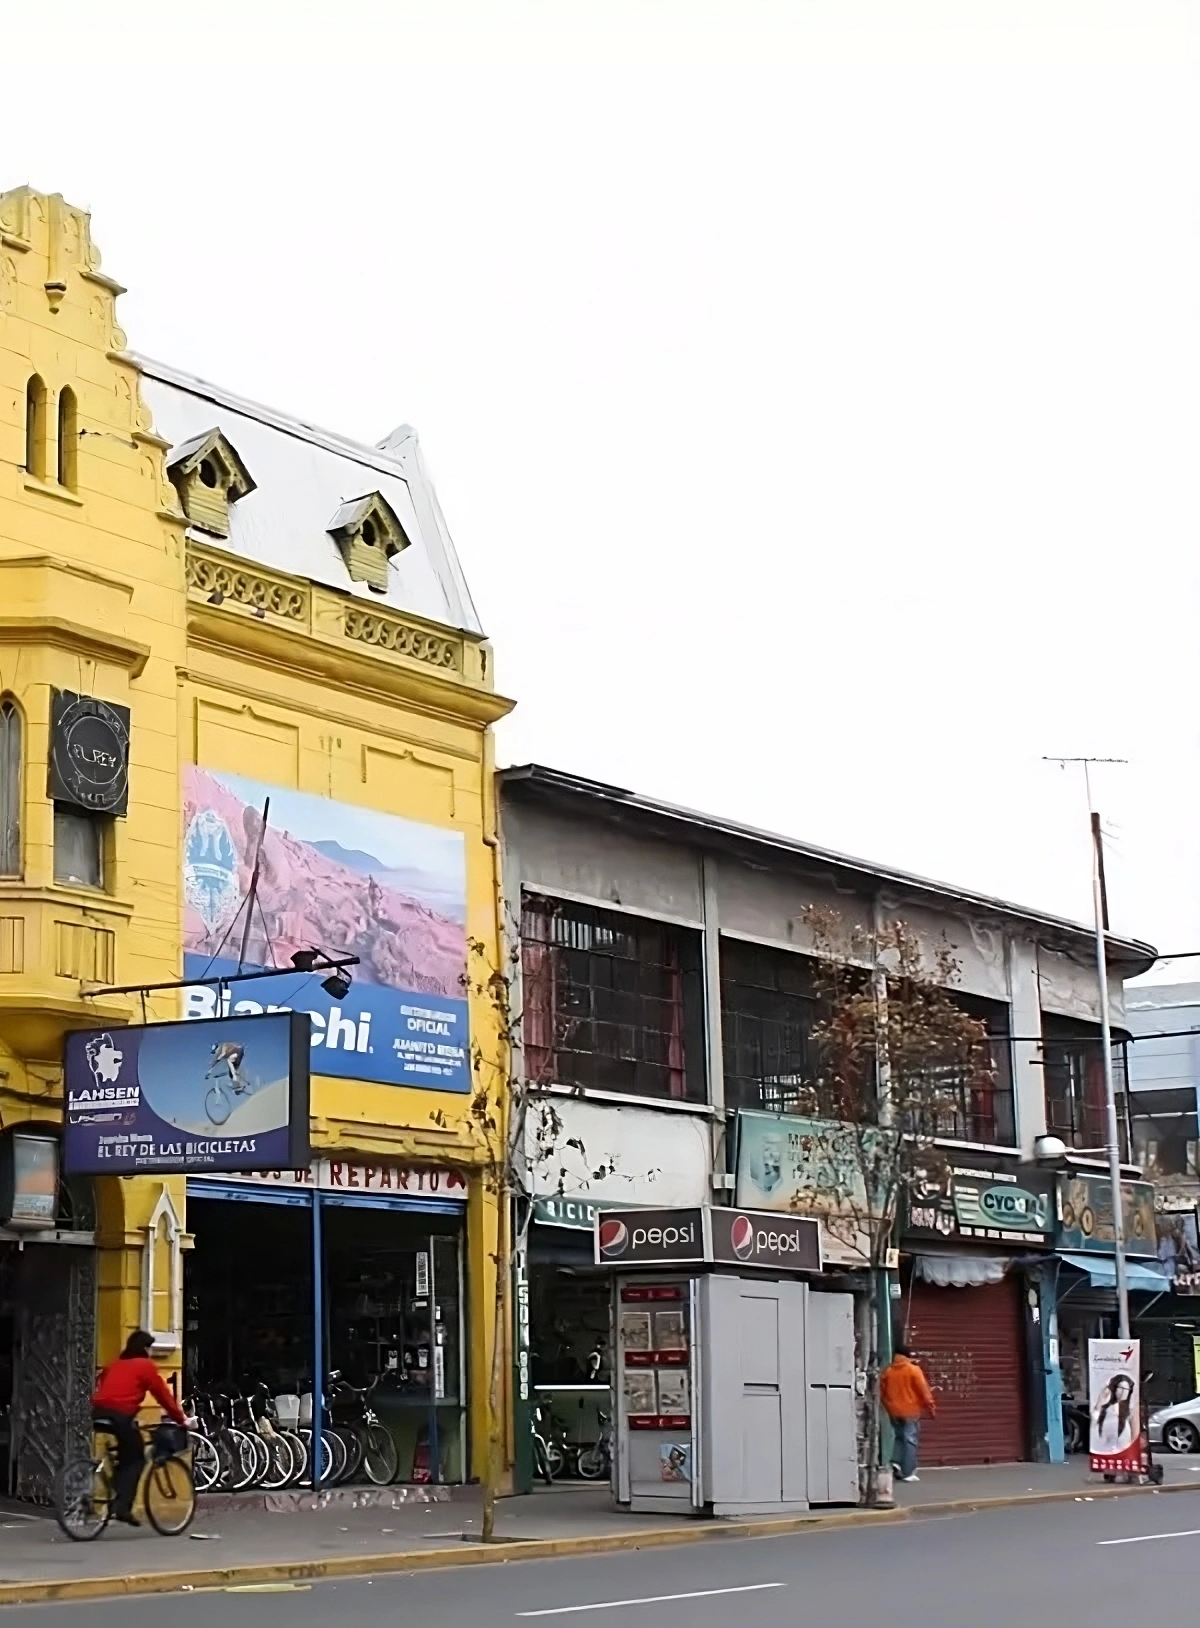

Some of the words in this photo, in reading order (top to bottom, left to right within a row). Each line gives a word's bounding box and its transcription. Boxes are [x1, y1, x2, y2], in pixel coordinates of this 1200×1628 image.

[68, 1086, 140, 1103] LANSEN
[97, 1143, 112, 1158] EL
[115, 1143, 137, 1158] REY
[140, 1143, 156, 1156] DE
[160, 1142, 182, 1155] LAS
[186, 1139, 256, 1155] BICICLETAS
[329, 1162, 440, 1191] REPARTO
[631, 1221, 695, 1249] pepsi
[757, 1229, 801, 1255] pepsi
